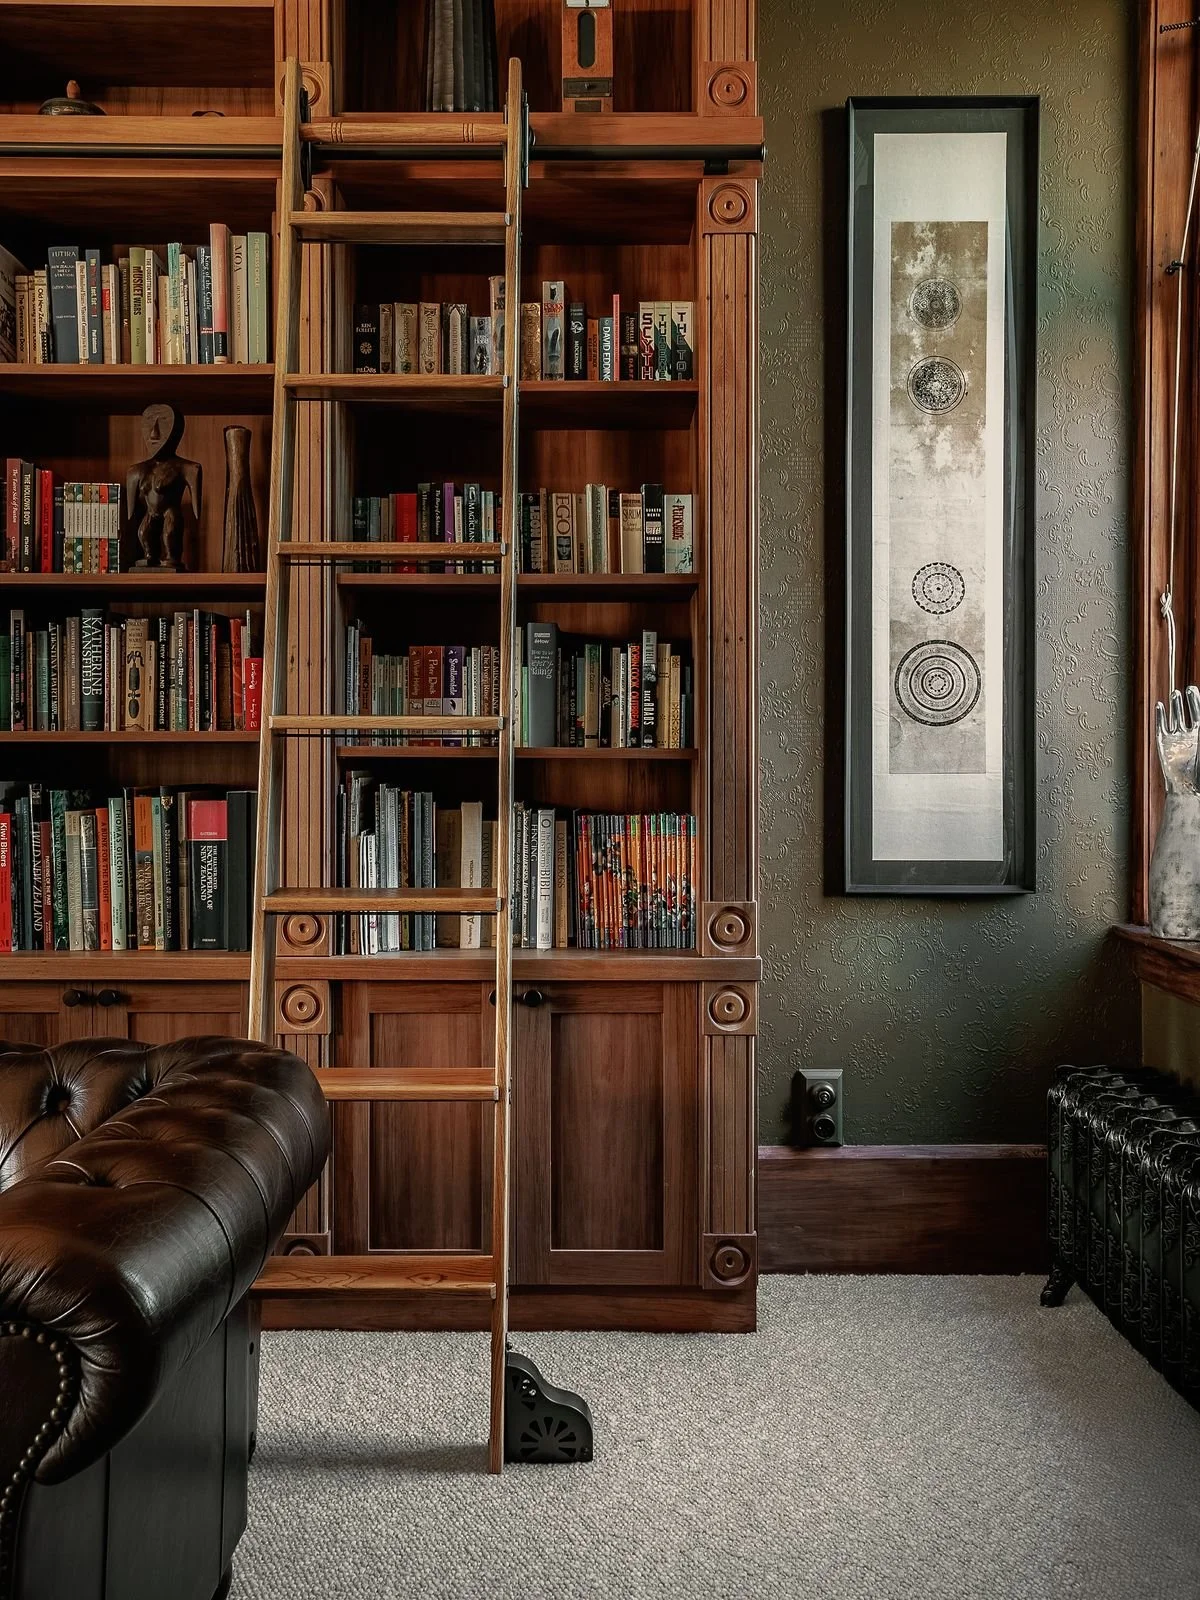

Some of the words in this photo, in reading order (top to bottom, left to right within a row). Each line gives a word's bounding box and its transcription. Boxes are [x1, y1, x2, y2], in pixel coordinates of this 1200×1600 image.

[234, 245, 242, 272] MOA
[133, 266, 143, 297] MUSKET
[677, 312, 686, 345] THE
[530, 506, 541, 537] LEON
[556, 495, 570, 535] EGO
[530, 540, 541, 570] URIS
[82, 617, 92, 696] MANSFIELD
[92, 617, 102, 696] KATHERINE
[178, 638, 182, 647] on
[630, 645, 640, 667] ROBIN
[428, 659, 438, 675] Peter
[448, 658, 458, 696] Swallowdale
[631, 667, 640, 688] COOK
[428, 677, 438, 694] Duck
[631, 691, 639, 728] OUTBREAK
[644, 702, 654, 725] ROADS
[32, 831, 41, 857] WILD
[557, 832, 565, 863] QUAKE
[33, 860, 42, 882] NEW
[69, 862, 74, 870] OF
[540, 870, 550, 901] BIBLE
[33, 885, 43, 931] ZEALAND
[207, 900, 213, 910] OF
